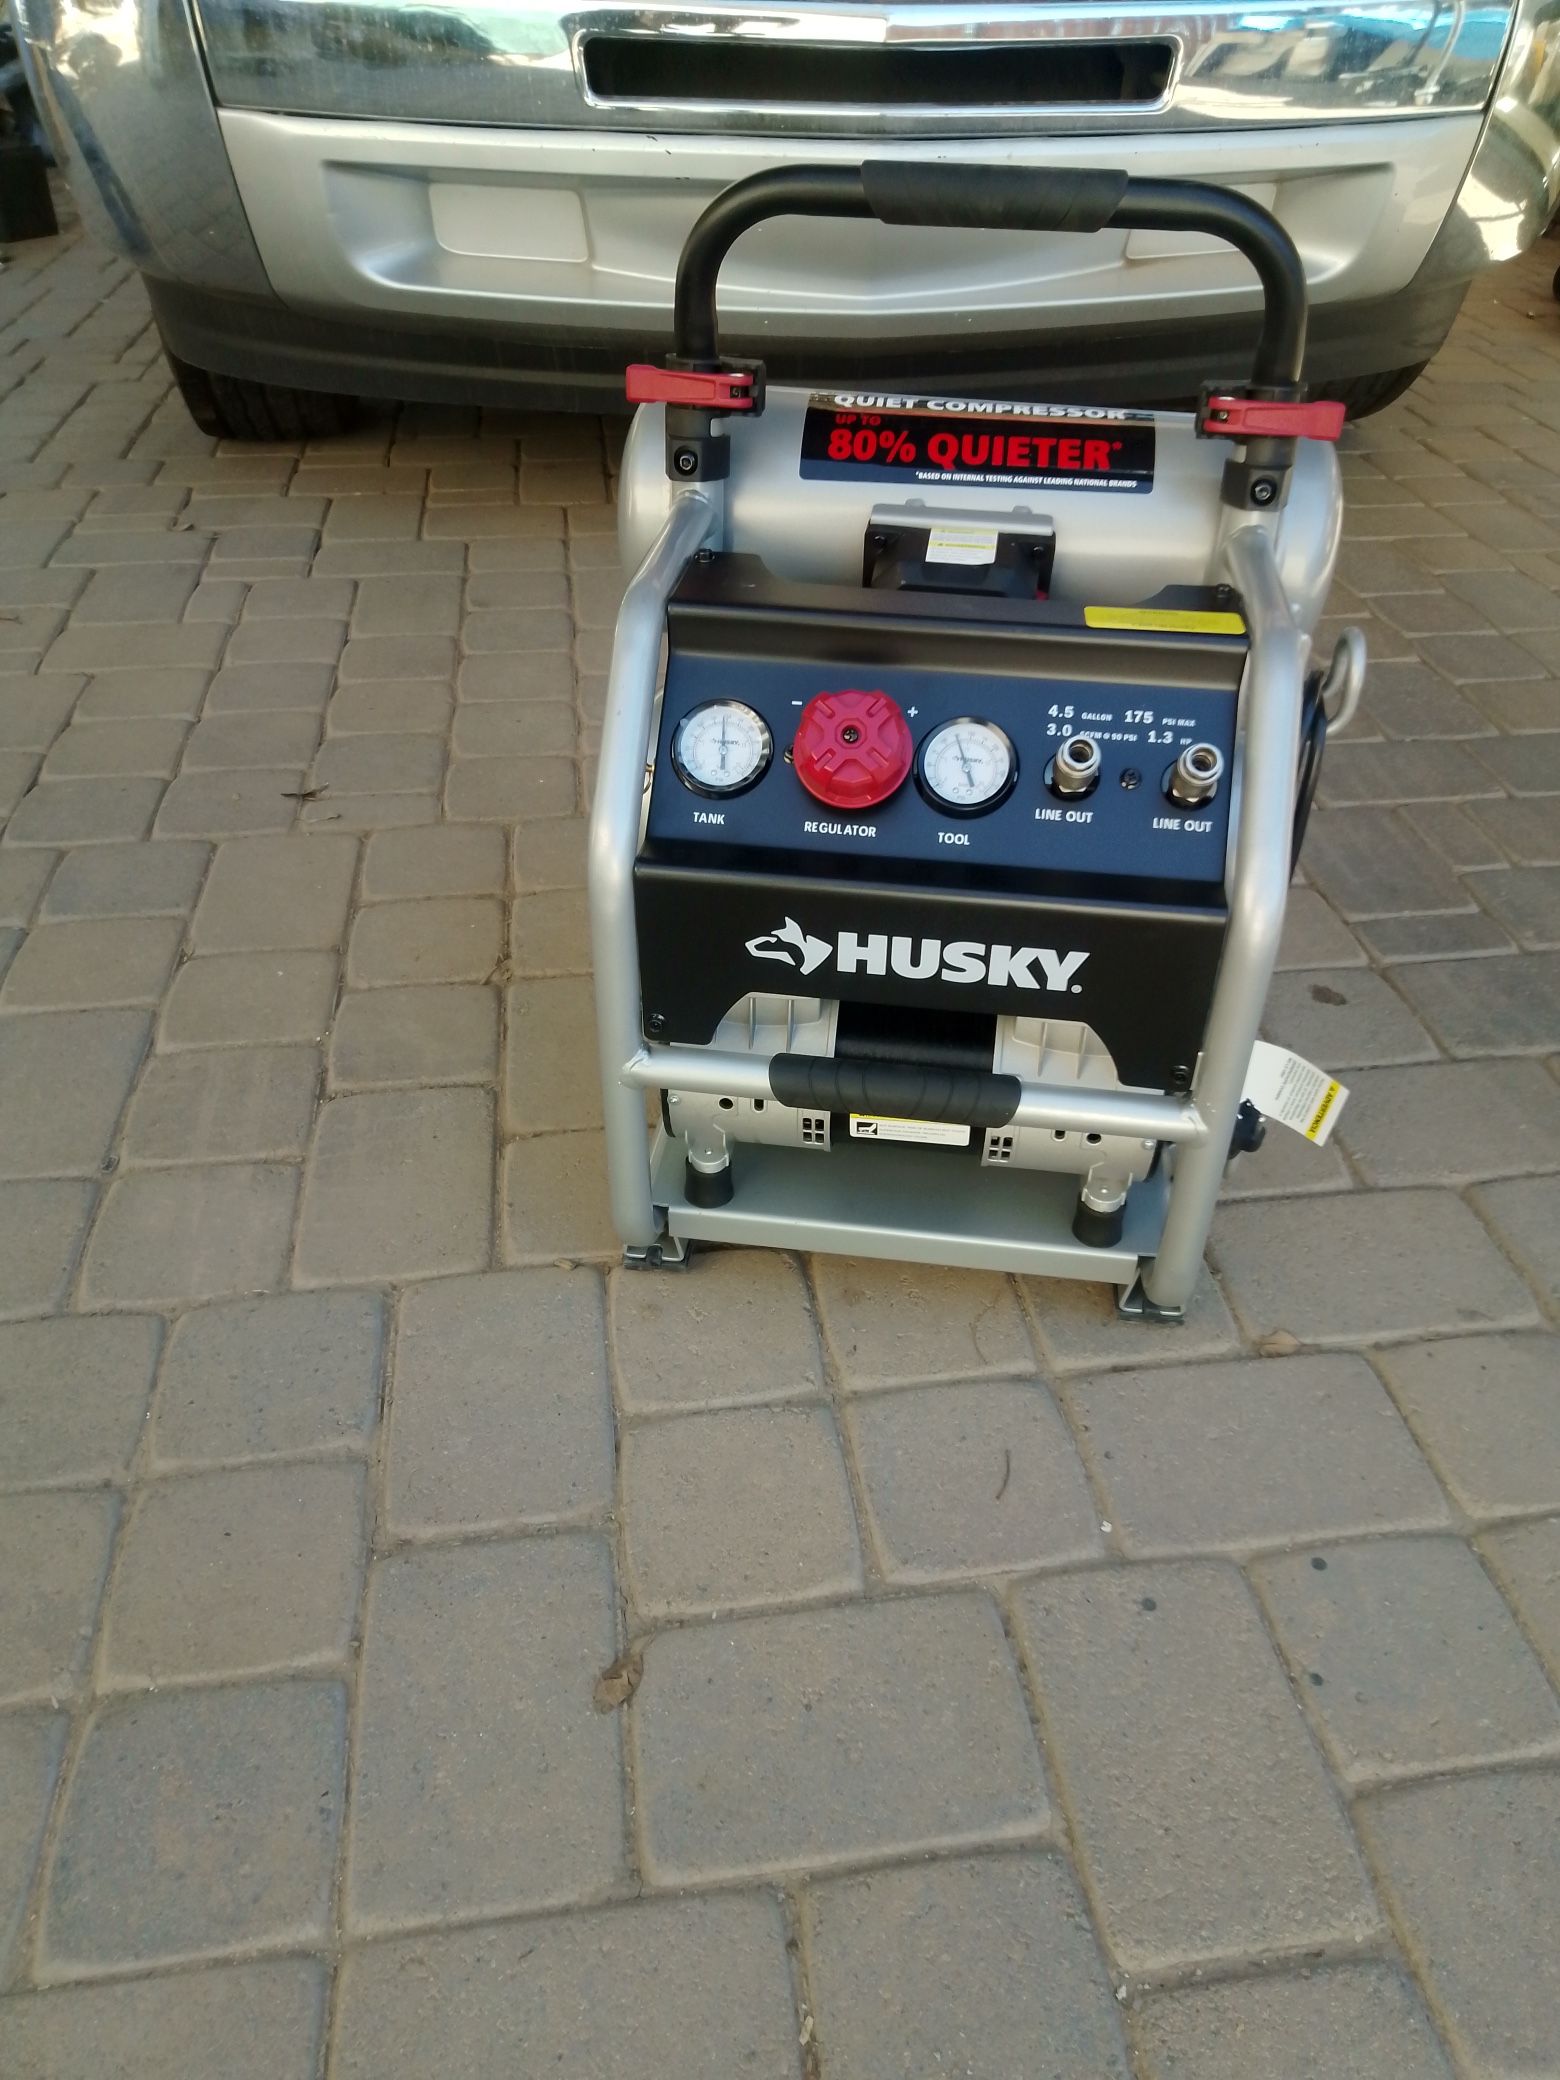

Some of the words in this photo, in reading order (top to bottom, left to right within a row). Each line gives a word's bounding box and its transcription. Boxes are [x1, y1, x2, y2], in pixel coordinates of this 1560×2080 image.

[834, 395, 919, 408] QUIET
[927, 400, 1127, 420] COMPRESSOR
[835, 414, 857, 424] UP
[861, 415, 882, 426] TO
[828, 428, 917, 463] 80%
[952, 473, 984, 482] INTERNAL
[985, 475, 1013, 483] TESTING
[1013, 475, 1043, 485] AGAINST
[1043, 477, 1073, 486] LEADING
[1073, 478, 1108, 487] NATIONAL
[1108, 480, 1138, 488] BRANDS
[1048, 705, 1075, 719] 4.5
[1081, 712, 1113, 722] GALLON
[1124, 710, 1154, 724] 175
[1162, 718, 1176, 726] PSI
[1177, 719, 1197, 728] MAX
[1046, 724, 1073, 737] 3.0
[1123, 733, 1138, 742] PSI
[1147, 730, 1174, 744] 1.3
[693, 811, 725, 825] TANK
[1035, 808, 1062, 822] LINE
[1066, 810, 1093, 824] OUT
[803, 821, 877, 838] REGULATOR
[1152, 817, 1181, 830] LINE
[1184, 819, 1212, 833] OUT
[937, 832, 970, 846] TOOL
